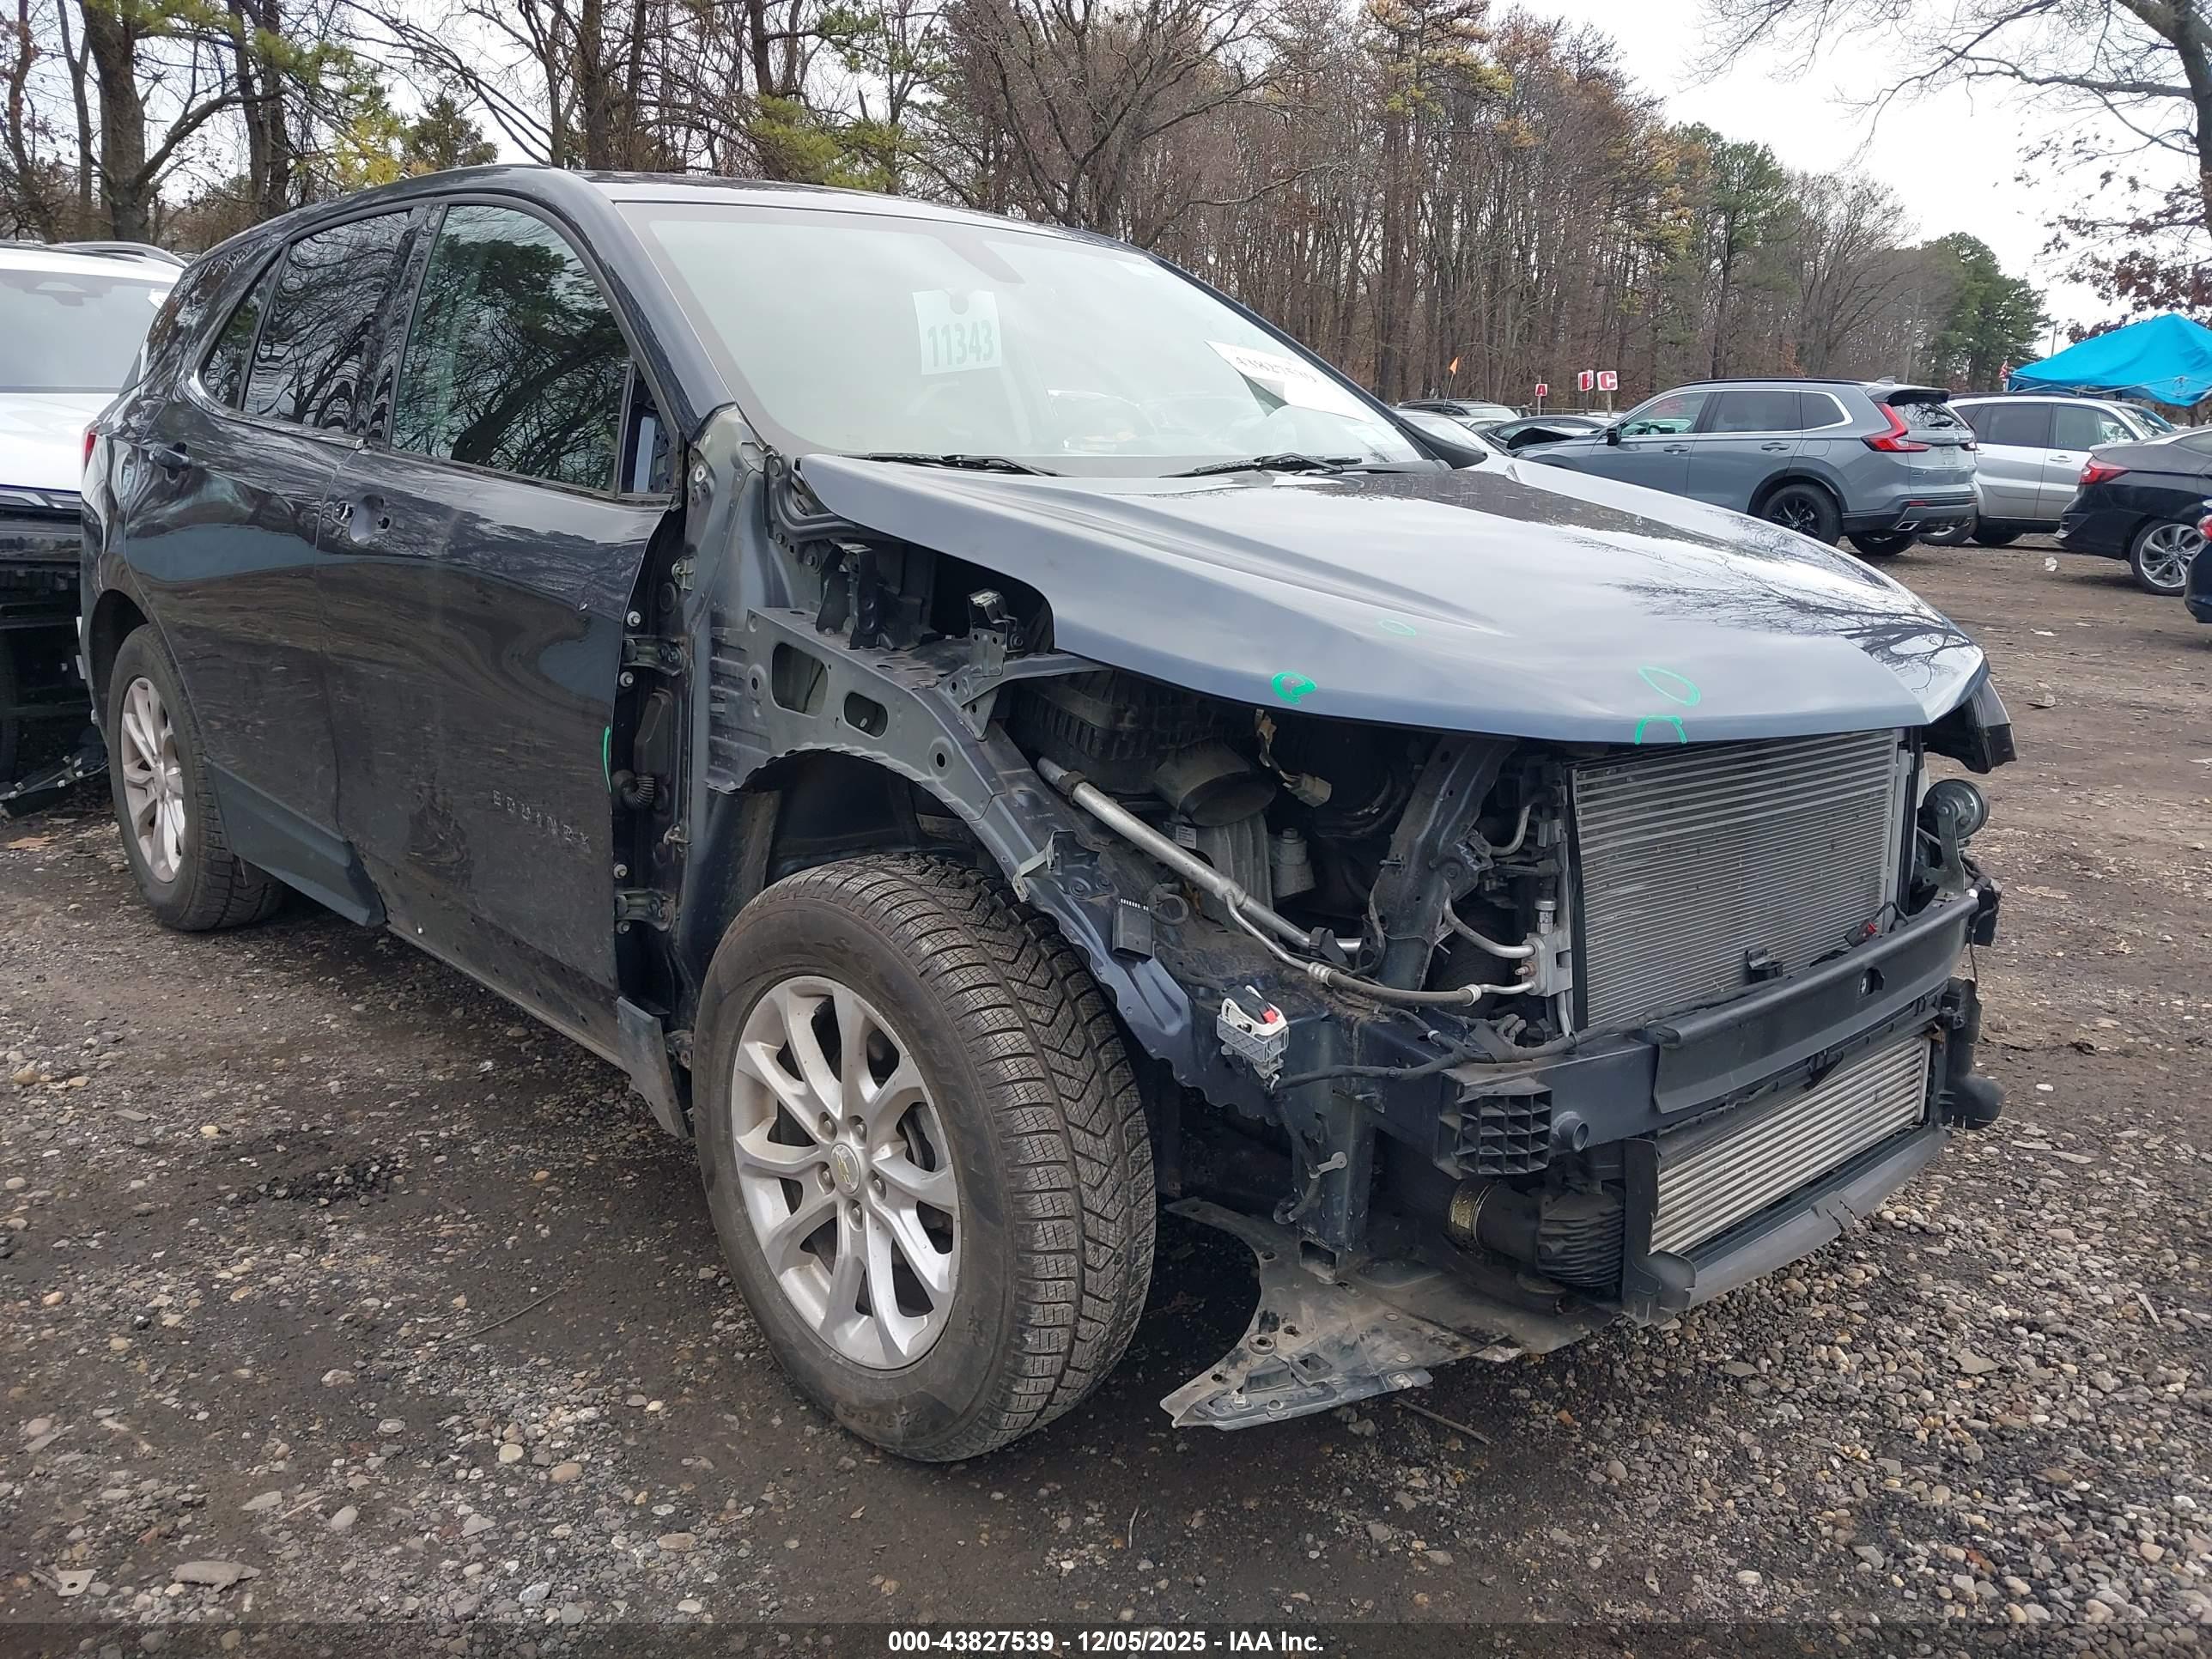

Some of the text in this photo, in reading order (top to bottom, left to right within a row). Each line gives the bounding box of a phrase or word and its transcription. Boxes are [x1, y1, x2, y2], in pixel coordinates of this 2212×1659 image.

[927, 319, 994, 368] 11343
[1600, 372, 1616, 389] C
[1536, 385, 1547, 396] A
